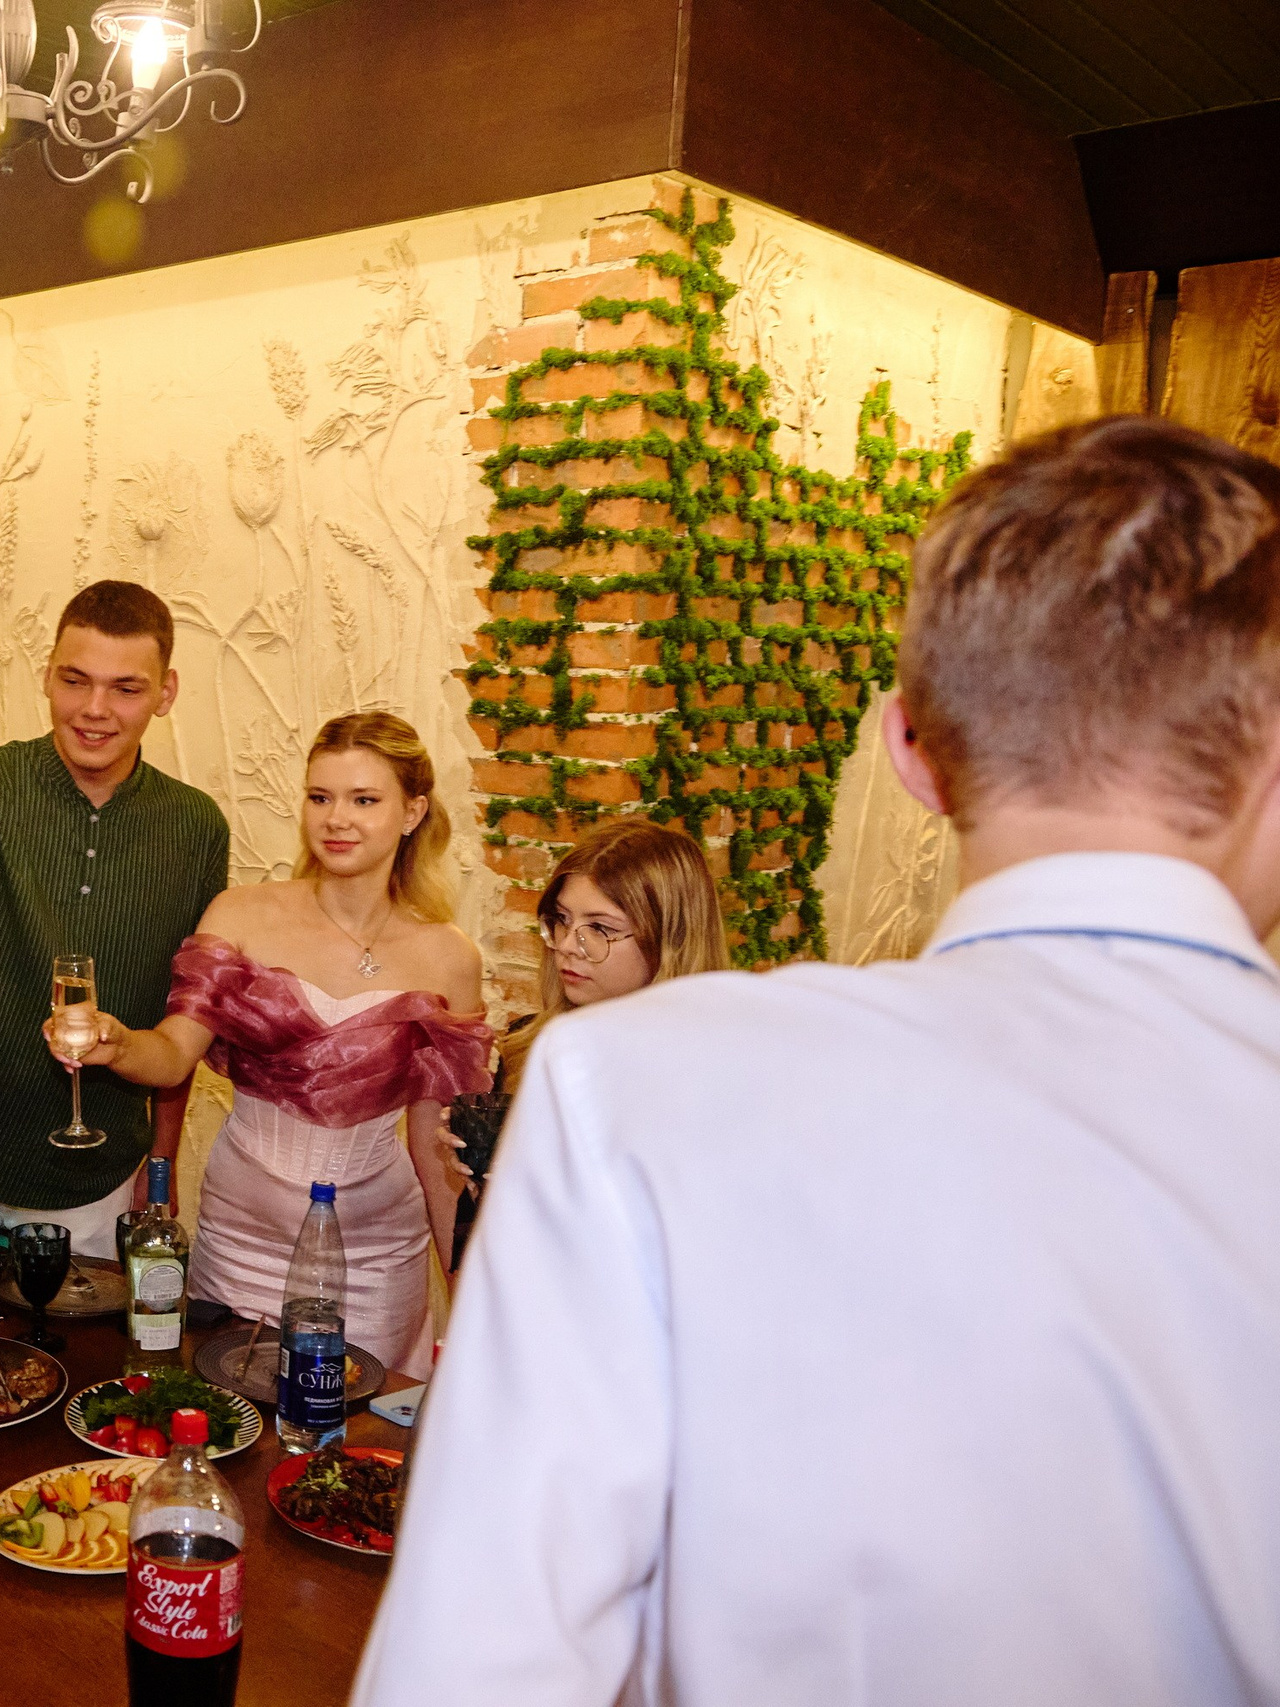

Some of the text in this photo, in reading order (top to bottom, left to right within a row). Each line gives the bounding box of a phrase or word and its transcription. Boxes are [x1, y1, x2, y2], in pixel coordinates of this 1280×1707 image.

[299, 1373, 344, 1389] СУНЖ
[137, 1563, 214, 1603] Export
[144, 1591, 198, 1625] Style
[171, 1620, 208, 1640] Cola
